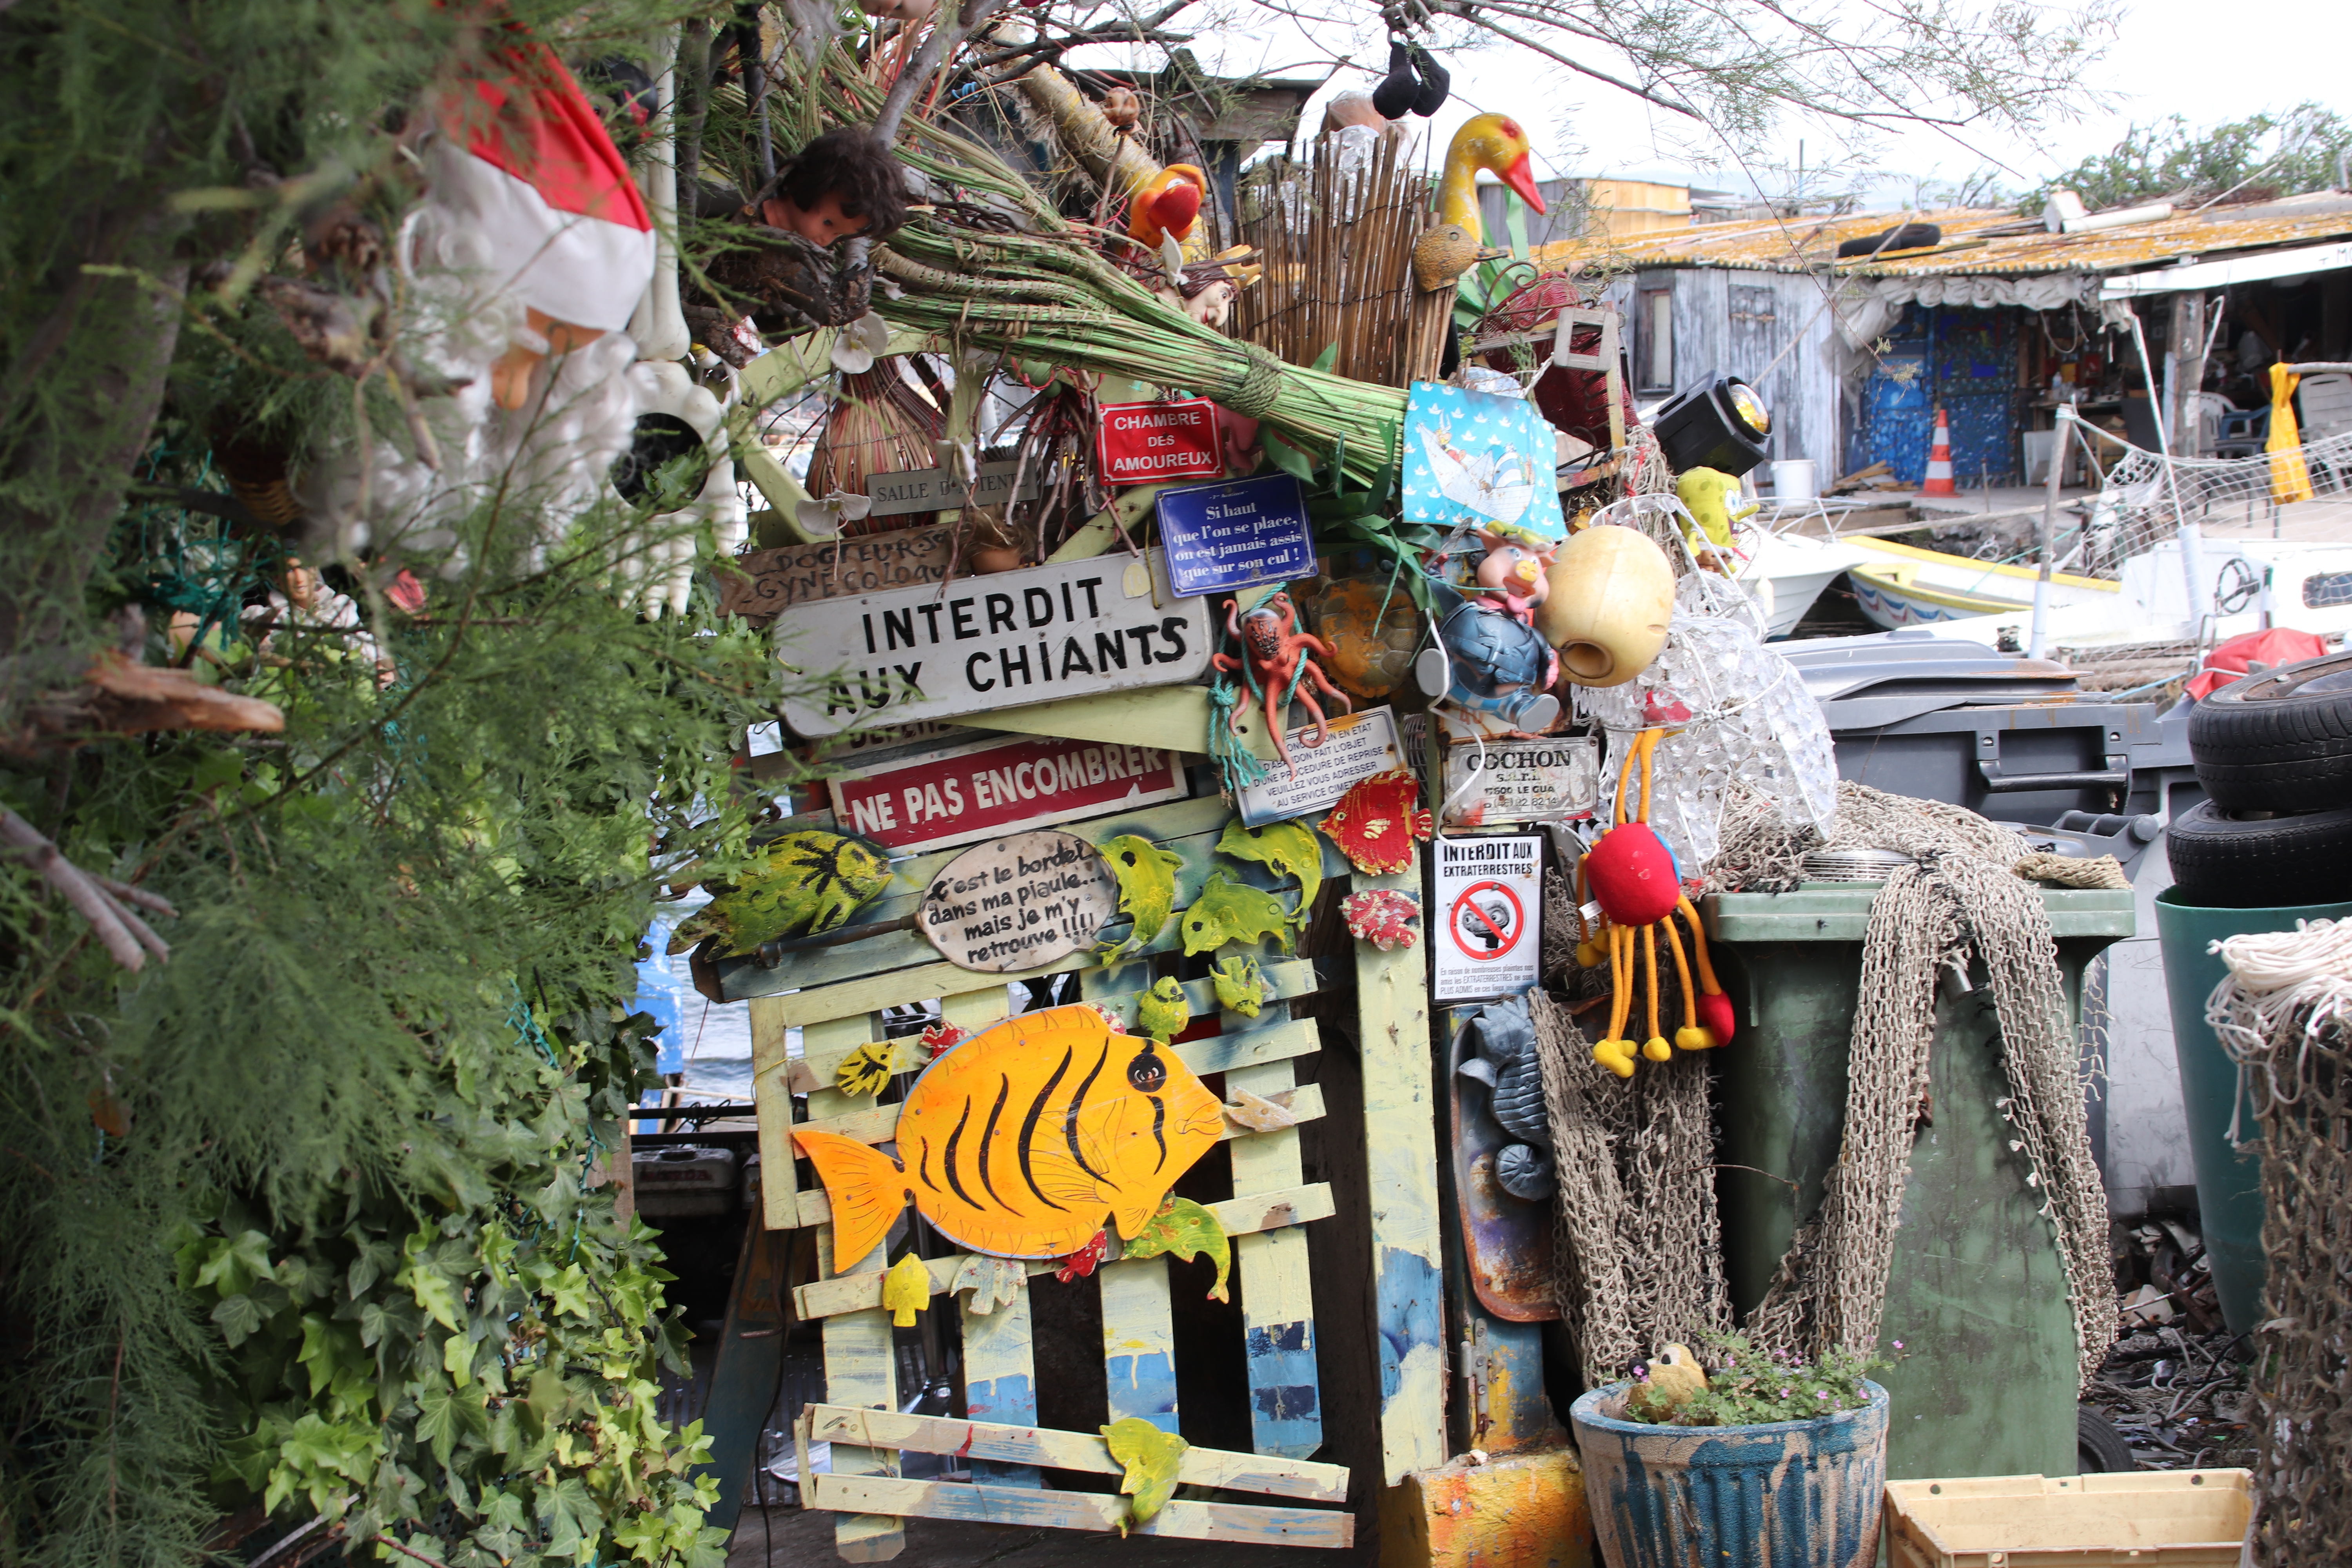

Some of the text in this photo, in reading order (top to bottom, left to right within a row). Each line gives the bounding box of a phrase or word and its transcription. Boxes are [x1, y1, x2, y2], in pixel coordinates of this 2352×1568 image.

[1114, 412, 1201, 430] CHAMBRE
[1147, 435, 1175, 447] DES
[1113, 451, 1212, 472] AMOUREUX
[877, 483, 929, 502] SALLE
[1205, 503, 1257, 521] Si haut
[1172, 516, 1298, 547] que l'on se place,
[1175, 530, 1303, 562] on est jamais assis
[1183, 547, 1300, 581] que sur son cul !
[863, 577, 1102, 654] INTERDIT
[827, 616, 1188, 716] AUX CHIANTS
[1339, 728, 1350, 739] EN
[1352, 722, 1372, 735] ETAT
[1314, 746, 1332, 758] FAIT
[1334, 737, 1367, 753] L'OBJET
[1254, 774, 1279, 787] DUNE
[1334, 756, 1347, 766] DE
[1348, 746, 1384, 762] REPRISE
[1466, 750, 1571, 771] COCHON
[851, 743, 1165, 836] NE PAS ENCOMBRER
[1265, 761, 1377, 797] VEUILLEZ VOUS ADRESSER
[1276, 798, 1289, 808] AU
[1290, 788, 1327, 804] SERVICE
[1443, 842, 1533, 862] INTERDIT AUX
[994, 866, 1014, 884] le
[1444, 863, 1532, 877] EXTRATERRESTRES
[929, 901, 978, 926] dans
[982, 891, 1014, 912] ma
[964, 895, 1080, 941] mais je m'y
[967, 927, 1058, 964] retrouve
[1448, 967, 1463, 975] raison
[1471, 965, 1502, 974] nombreuses
[1463, 973, 1513, 984] EXTRATERRESTRES
[1440, 986, 1455, 995] PLUS
[1455, 985, 1473, 994] ADMIS
